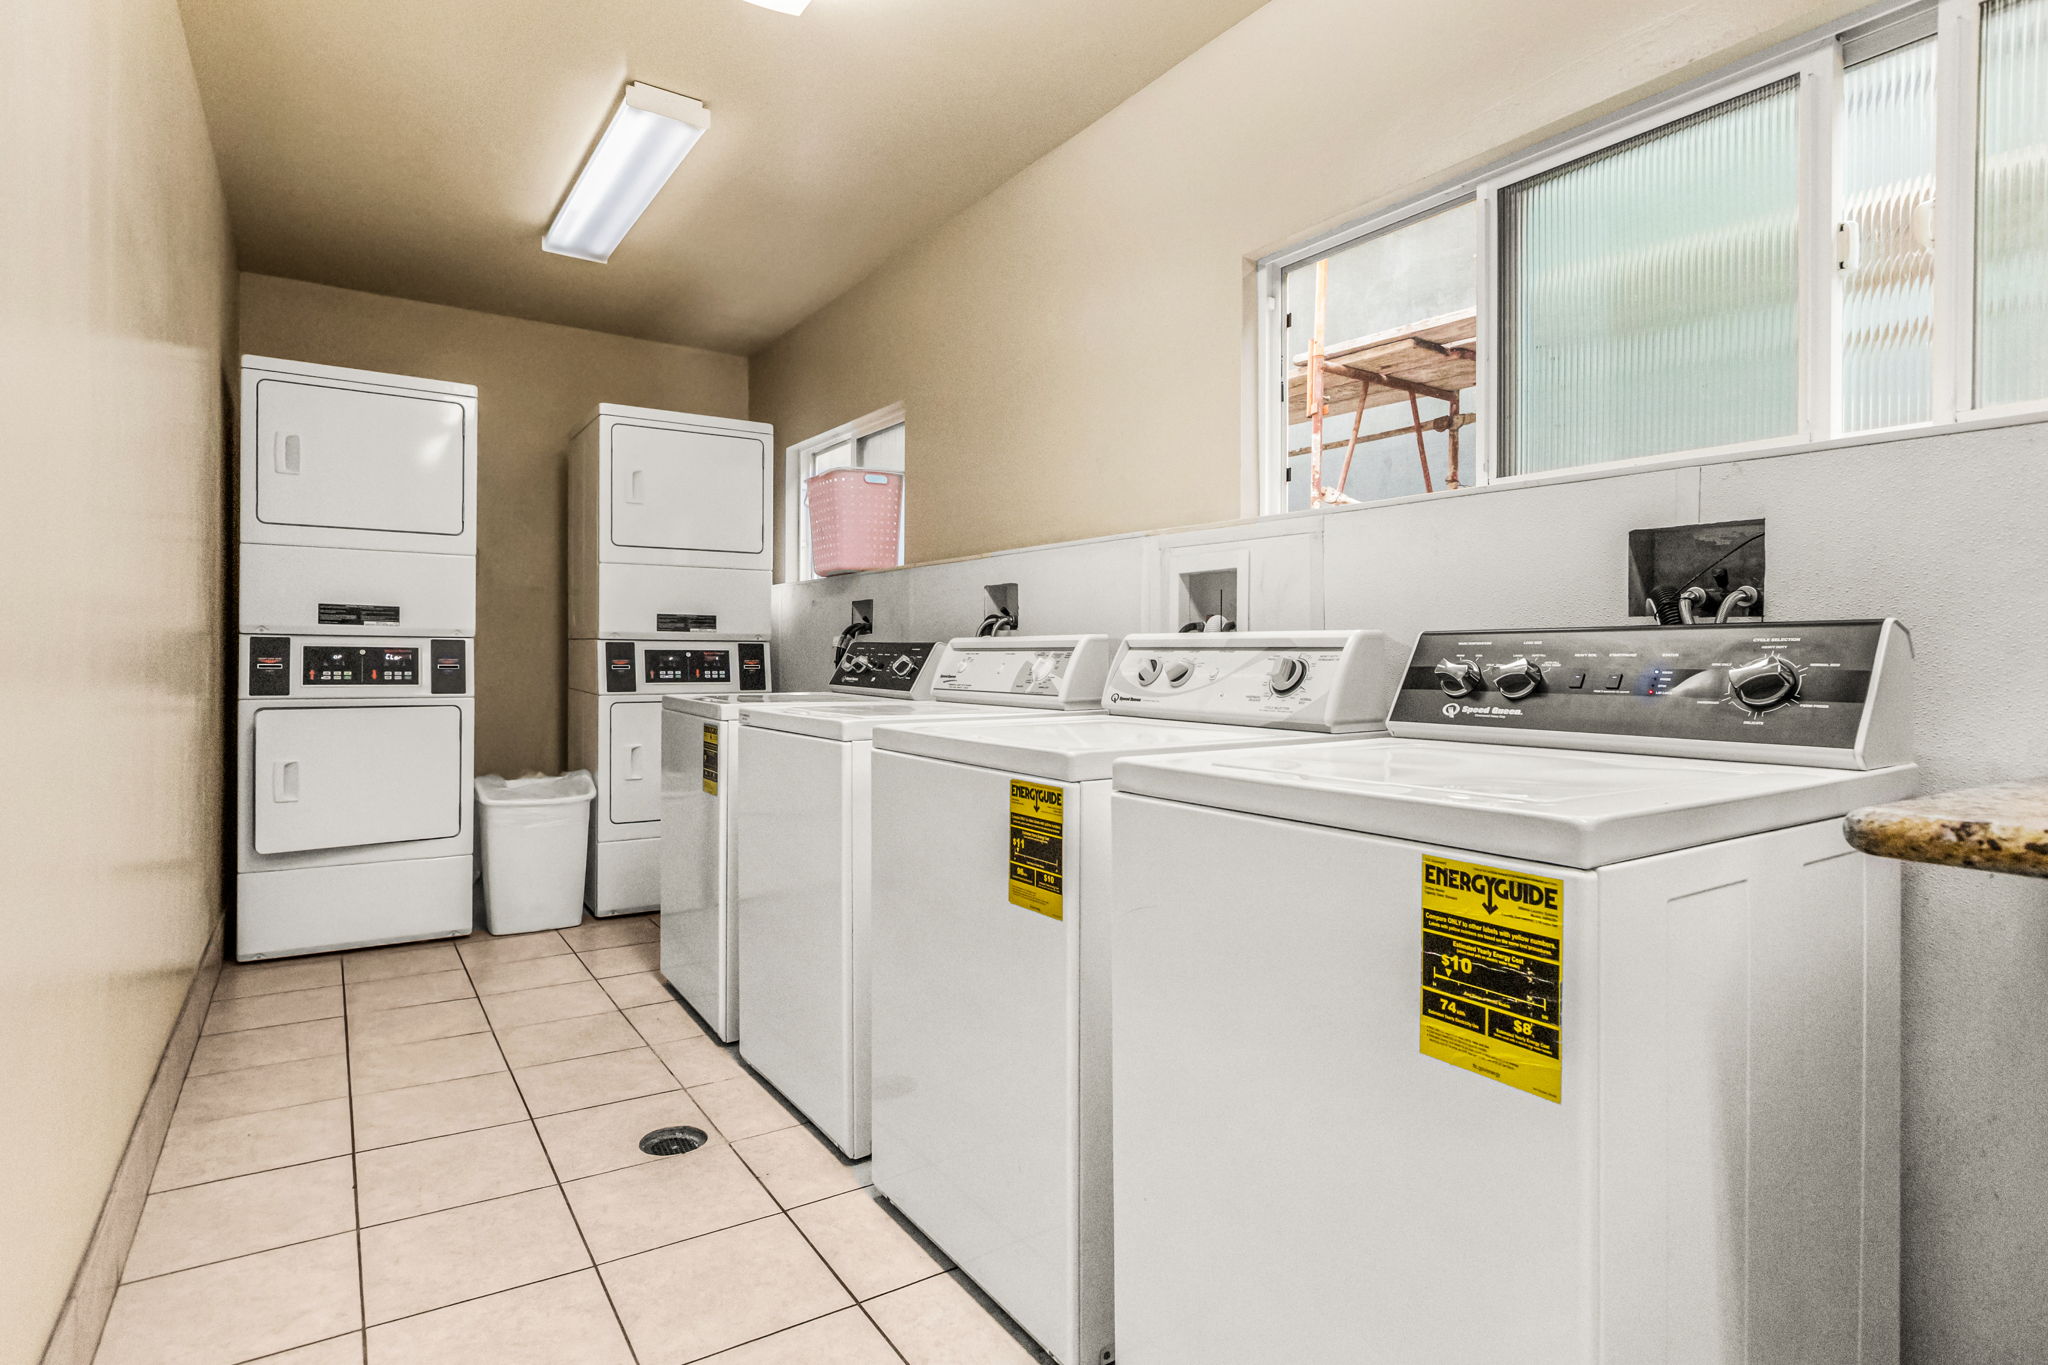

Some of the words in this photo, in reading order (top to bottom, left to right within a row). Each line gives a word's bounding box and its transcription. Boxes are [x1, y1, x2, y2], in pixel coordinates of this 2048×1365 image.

[1461, 705, 1491, 714] Speed
[1011, 784, 1062, 806] ENERGYGUIDE
[1424, 863, 1558, 911] ENERGYGUIDE
[1425, 912, 1447, 923] Compare
[1447, 917, 1462, 926] ONLY
[1468, 923, 1482, 931] other
[1482, 926, 1499, 936] labels
[1499, 930, 1511, 939] with
[1511, 933, 1530, 943] yellow
[1452, 940, 1477, 953] Estimated
[1477, 946, 1492, 958] Yearly
[1492, 950, 1511, 963] Energy
[1511, 955, 1525, 965] Cost
[1441, 954, 1473, 975] $10
[1440, 998, 1456, 1013] 74
[1513, 1020, 1533, 1036] $8
